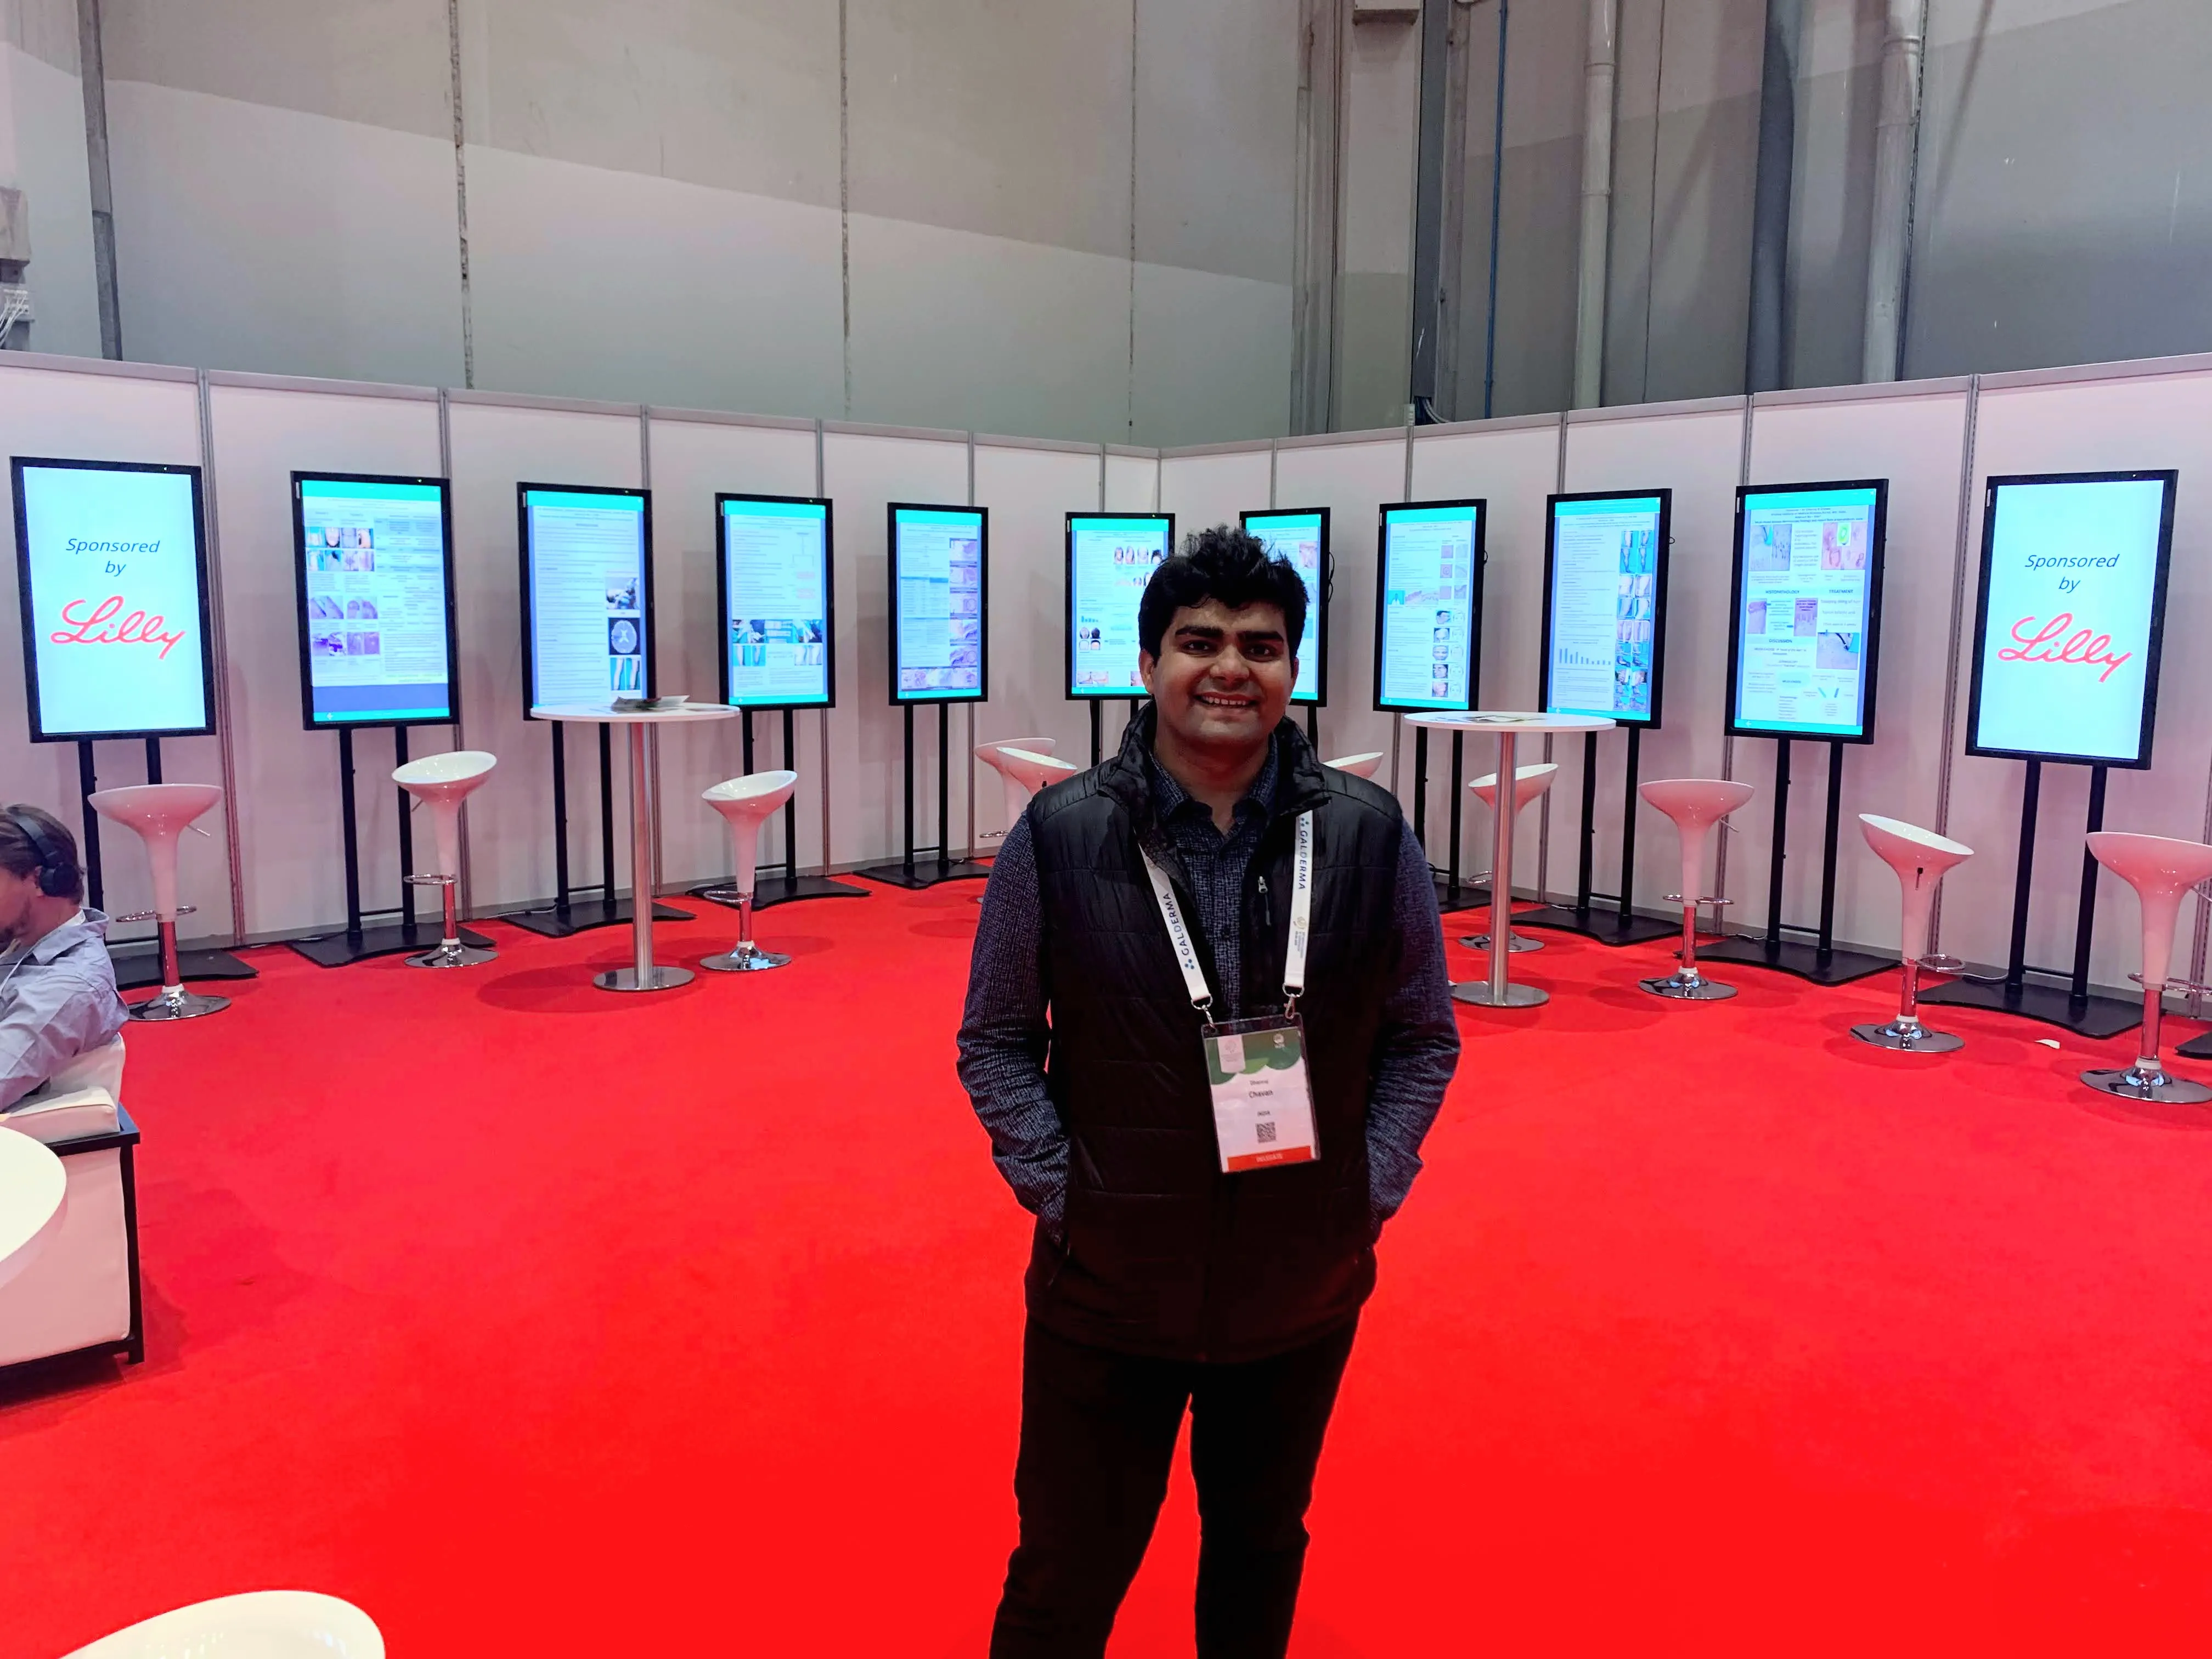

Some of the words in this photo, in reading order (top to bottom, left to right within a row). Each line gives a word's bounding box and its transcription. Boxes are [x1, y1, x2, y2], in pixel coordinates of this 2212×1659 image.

[65, 538, 160, 555] Sponsored
[105, 560, 126, 577] by
[2024, 554, 2120, 571] Sponsored
[2058, 576, 2081, 594] by
[50, 595, 186, 659] Lilly
[1997, 612, 2133, 683] Lilly
[1299, 830, 1308, 890] GALDERMA
[1163, 893, 1189, 956] GALDERMA
[1249, 1090, 1273, 1098] Chavan
